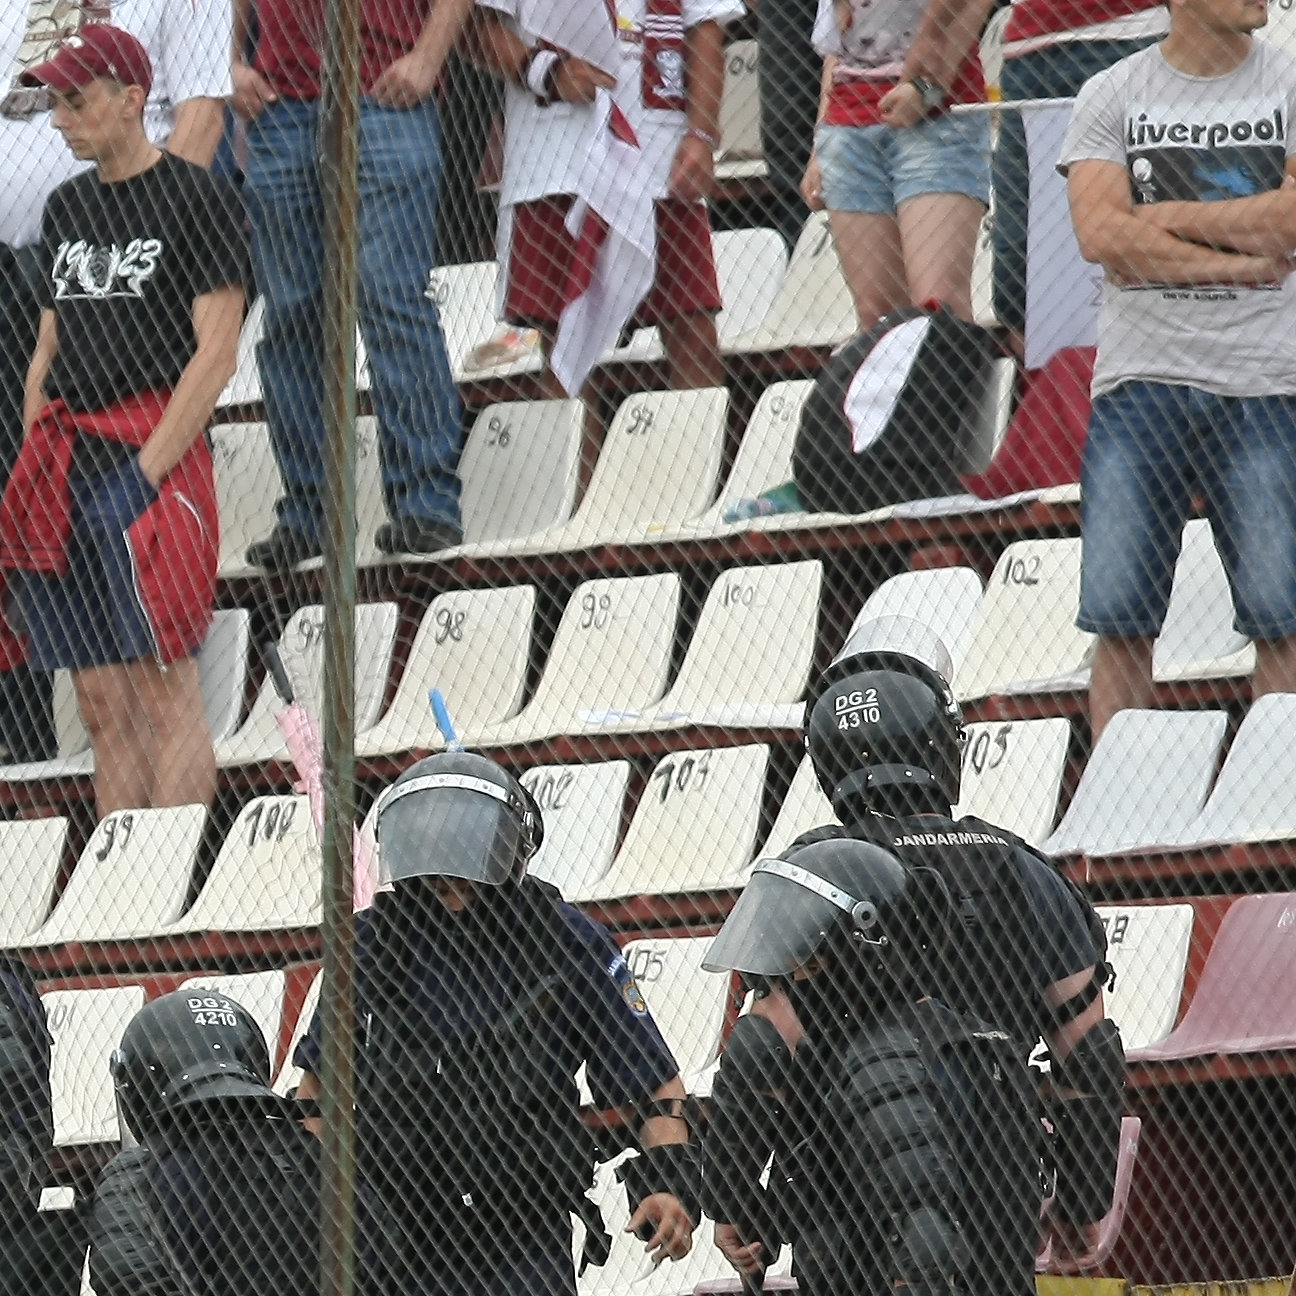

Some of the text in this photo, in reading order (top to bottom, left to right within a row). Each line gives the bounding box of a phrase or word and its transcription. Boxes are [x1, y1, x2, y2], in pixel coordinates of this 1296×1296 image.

[1126, 108, 1285, 149] Liverpool
[51, 238, 164, 279] 19 23
[1003, 555, 1041, 586] 102
[435, 608, 465, 645] 98
[838, 708, 880, 731] 4310
[893, 831, 1010, 848] JANDARMERIA
[194, 1010, 237, 1027] 4210
